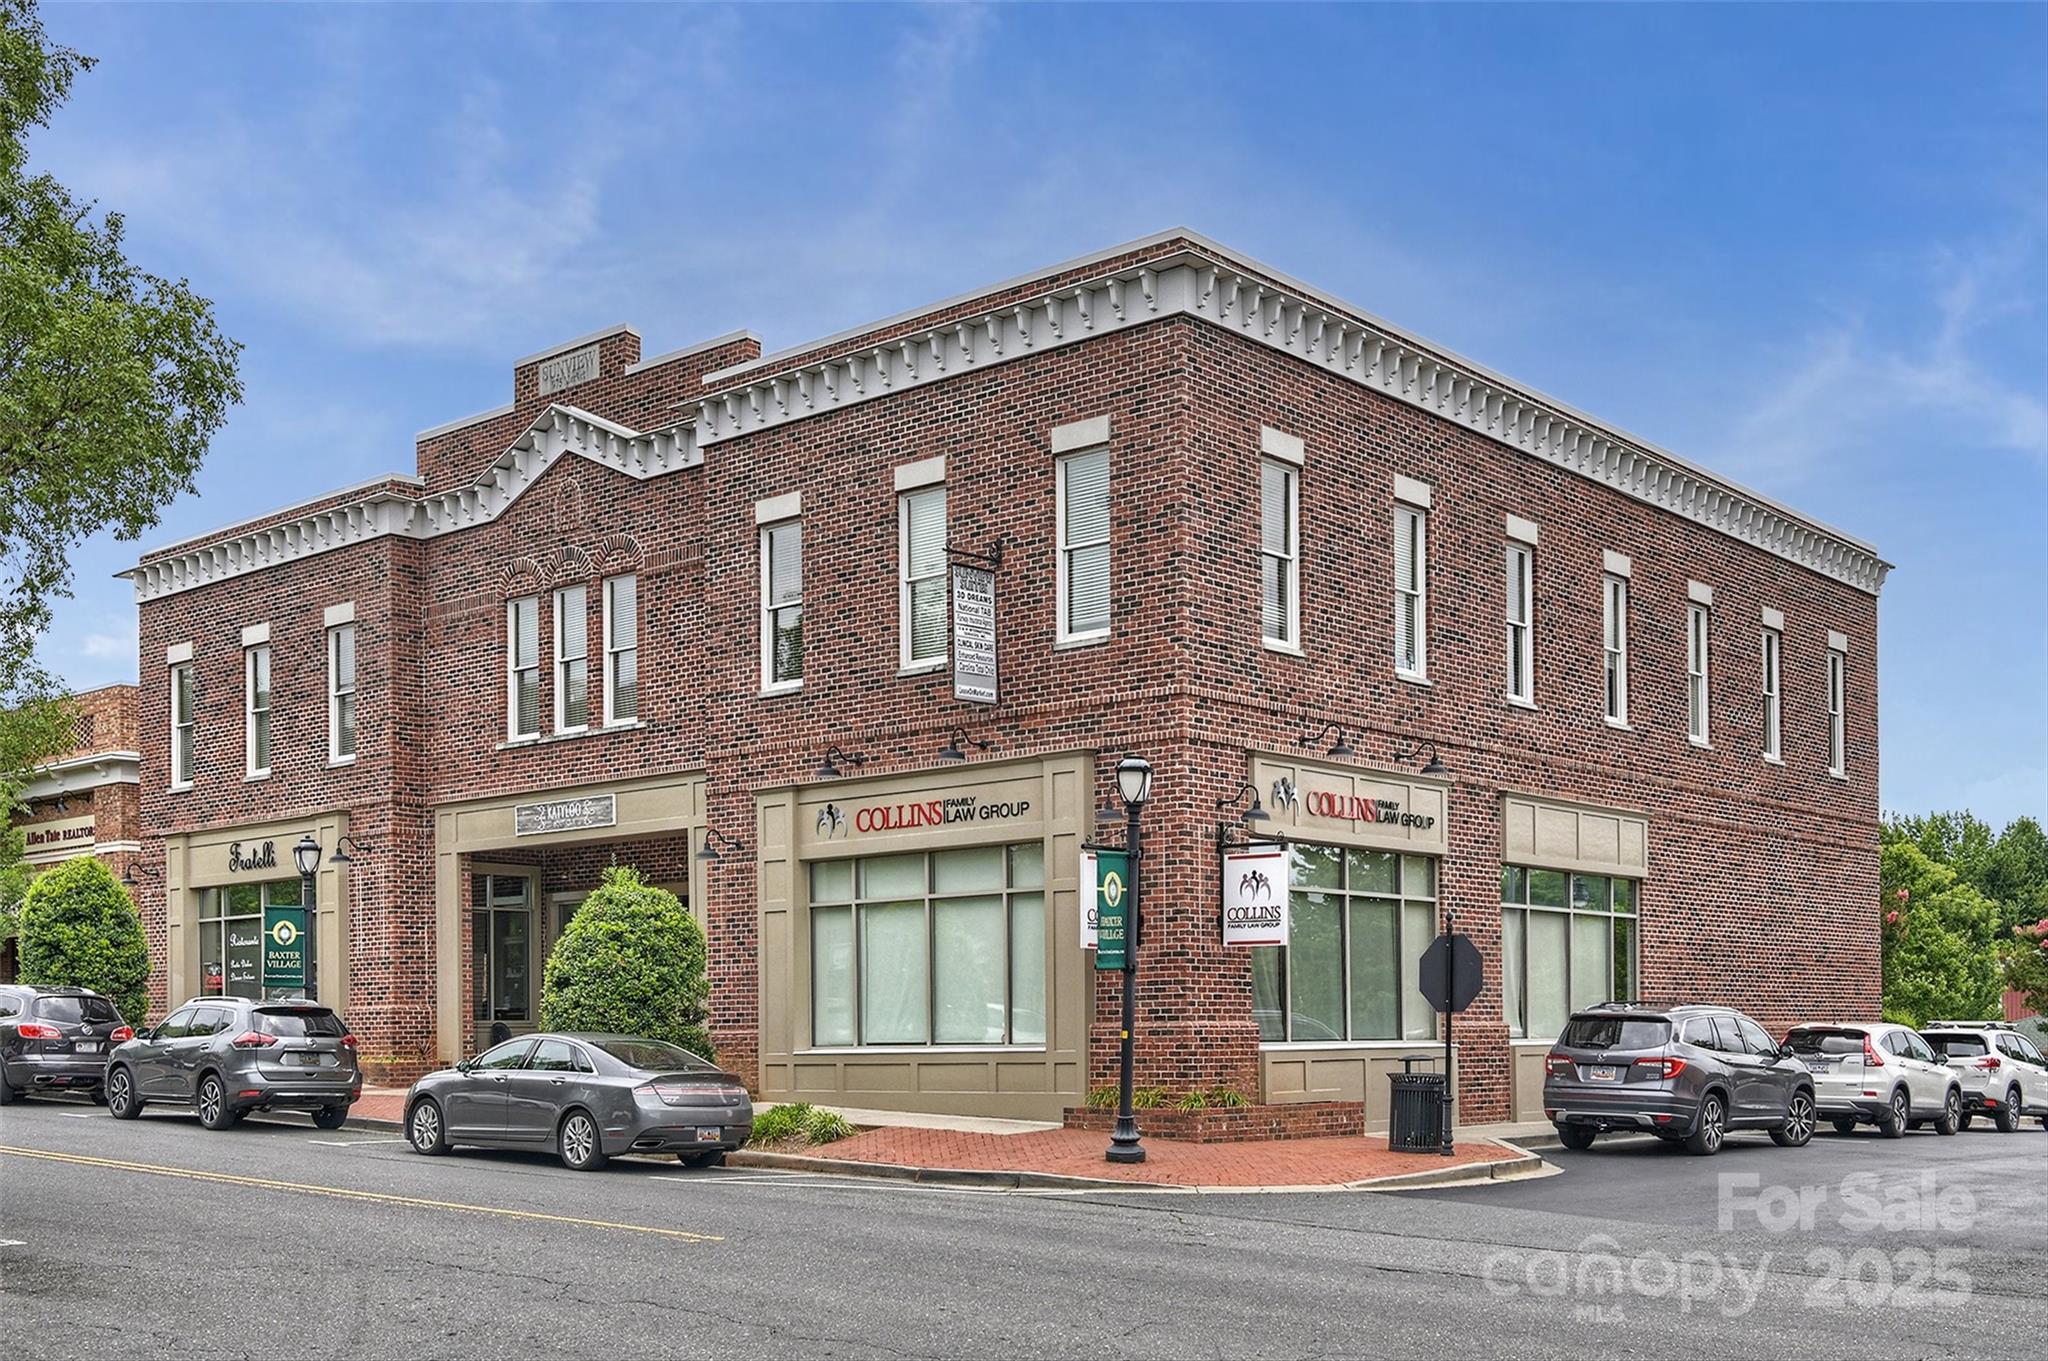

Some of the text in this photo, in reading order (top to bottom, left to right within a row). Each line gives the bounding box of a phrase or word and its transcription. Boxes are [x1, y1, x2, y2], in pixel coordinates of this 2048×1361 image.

[946, 796, 976, 808] FAMILY
[1306, 790, 1377, 823] COLLINS
[1377, 799, 1400, 810] FAMILY
[856, 800, 943, 832] COLLINS
[946, 801, 1030, 823] LAW GROUP
[1377, 808, 1435, 830] LAW GROUP
[229, 841, 276, 872] Fratelli
[1227, 905, 1281, 920] COLLINS
[266, 960, 302, 969] VILLAGE
[268, 951, 301, 960] BAXTER
